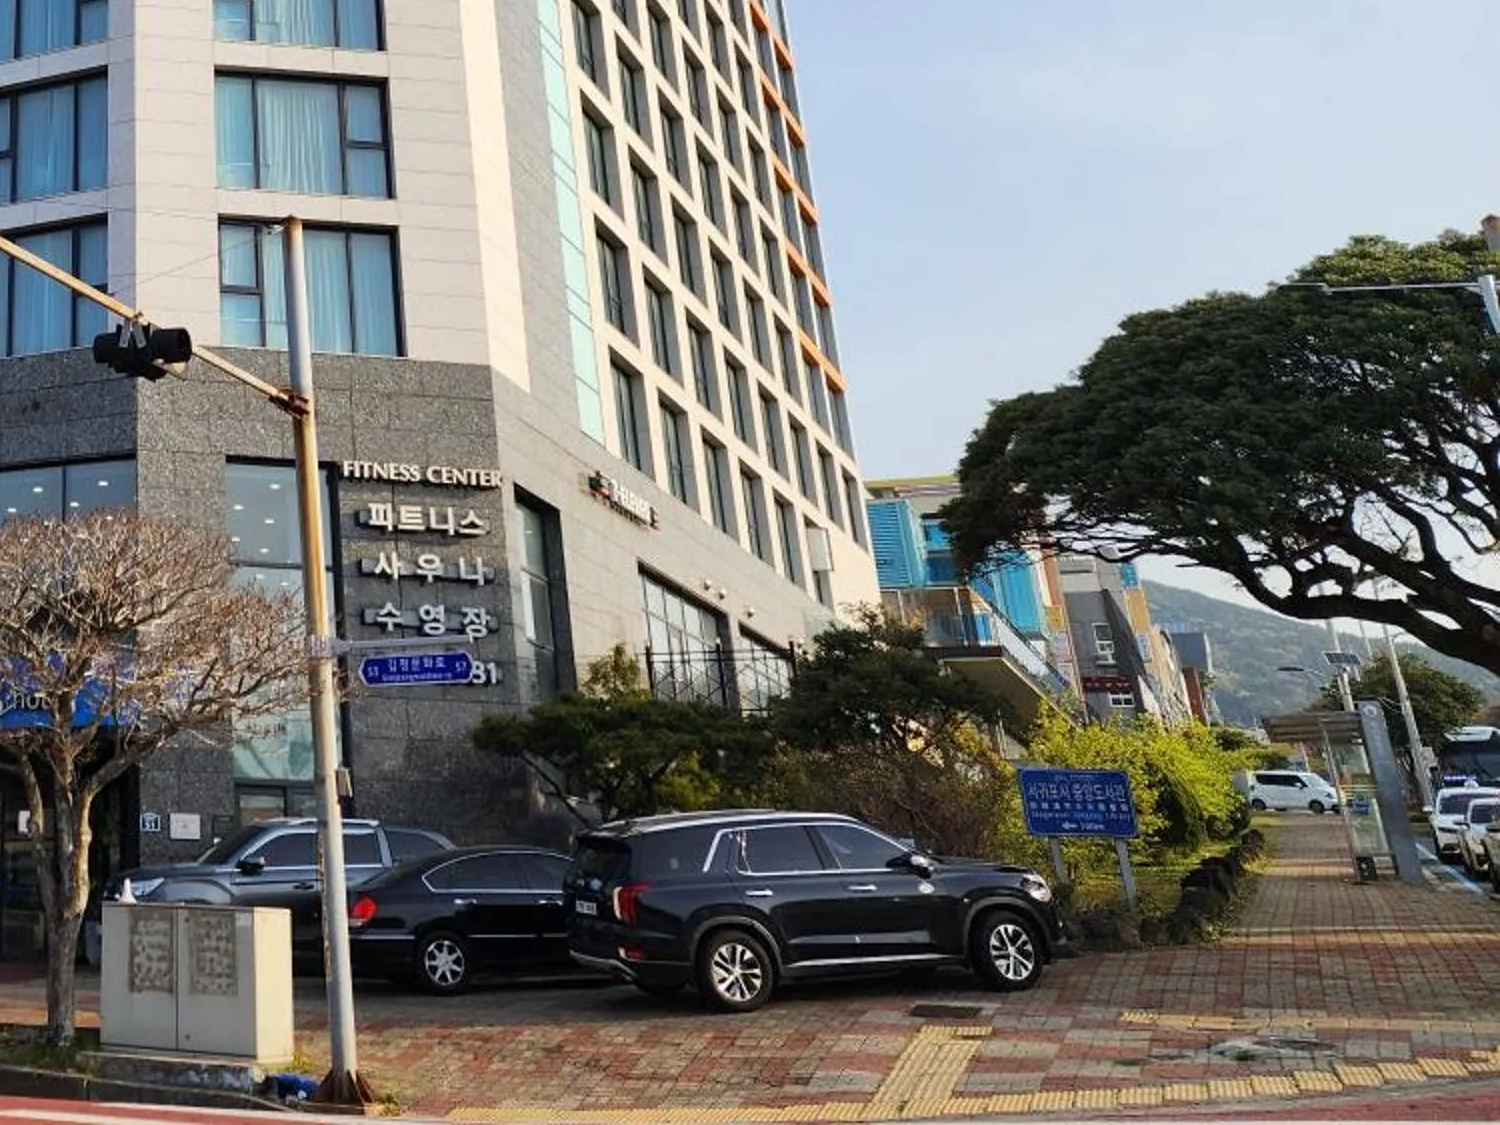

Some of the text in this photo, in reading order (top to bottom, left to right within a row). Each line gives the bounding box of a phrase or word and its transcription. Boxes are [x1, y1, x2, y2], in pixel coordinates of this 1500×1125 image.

[343, 460, 502, 487] FITNESS CENTER
[367, 502, 489, 536] 피트니스
[373, 551, 490, 586] 사우나
[376, 602, 492, 638] 수영장
